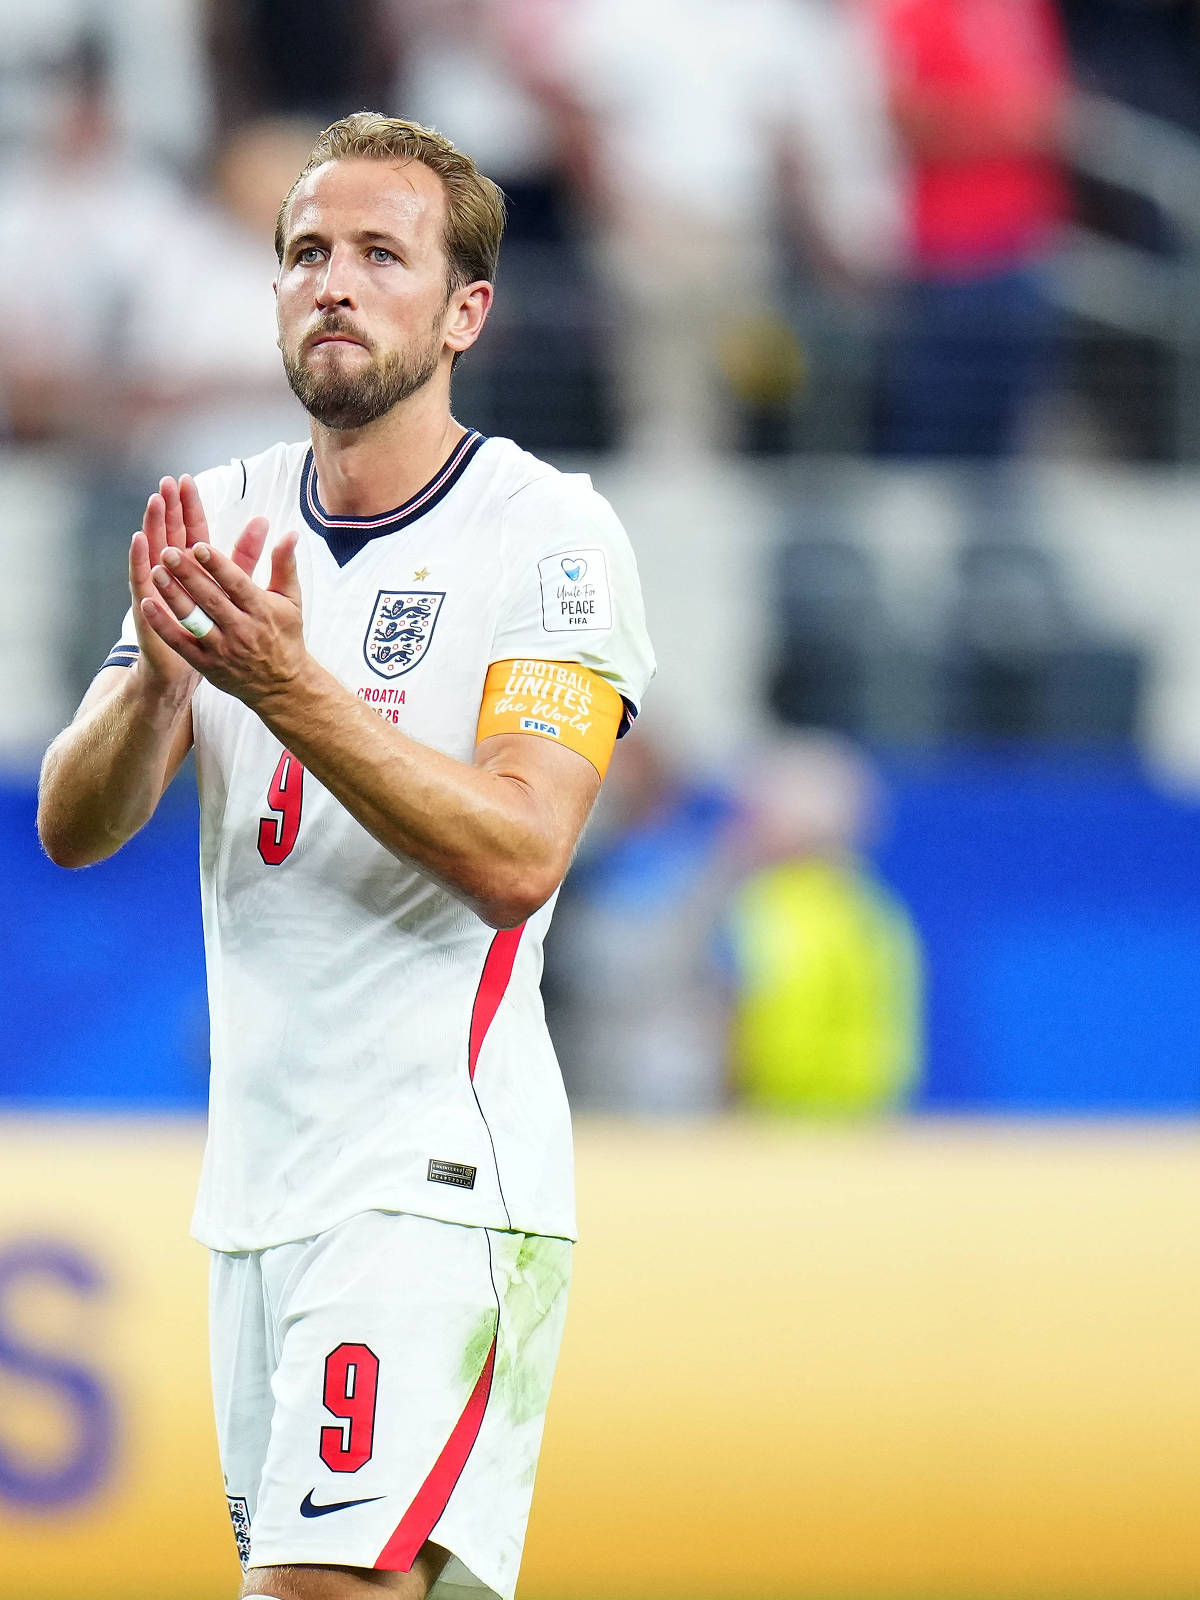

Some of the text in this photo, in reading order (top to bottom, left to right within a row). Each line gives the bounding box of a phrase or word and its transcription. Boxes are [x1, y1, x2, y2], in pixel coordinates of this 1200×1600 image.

[561, 600, 595, 615] PEACE
[569, 617, 588, 625] FIFA
[357, 687, 406, 705] CROATIA
[504, 675, 592, 716] UNITES
[511, 660, 593, 698] FOOTBALL
[494, 695, 593, 736] the World
[524, 719, 557, 736] FIFA
[257, 748, 305, 866] 9
[319, 1342, 380, 1473] 9
